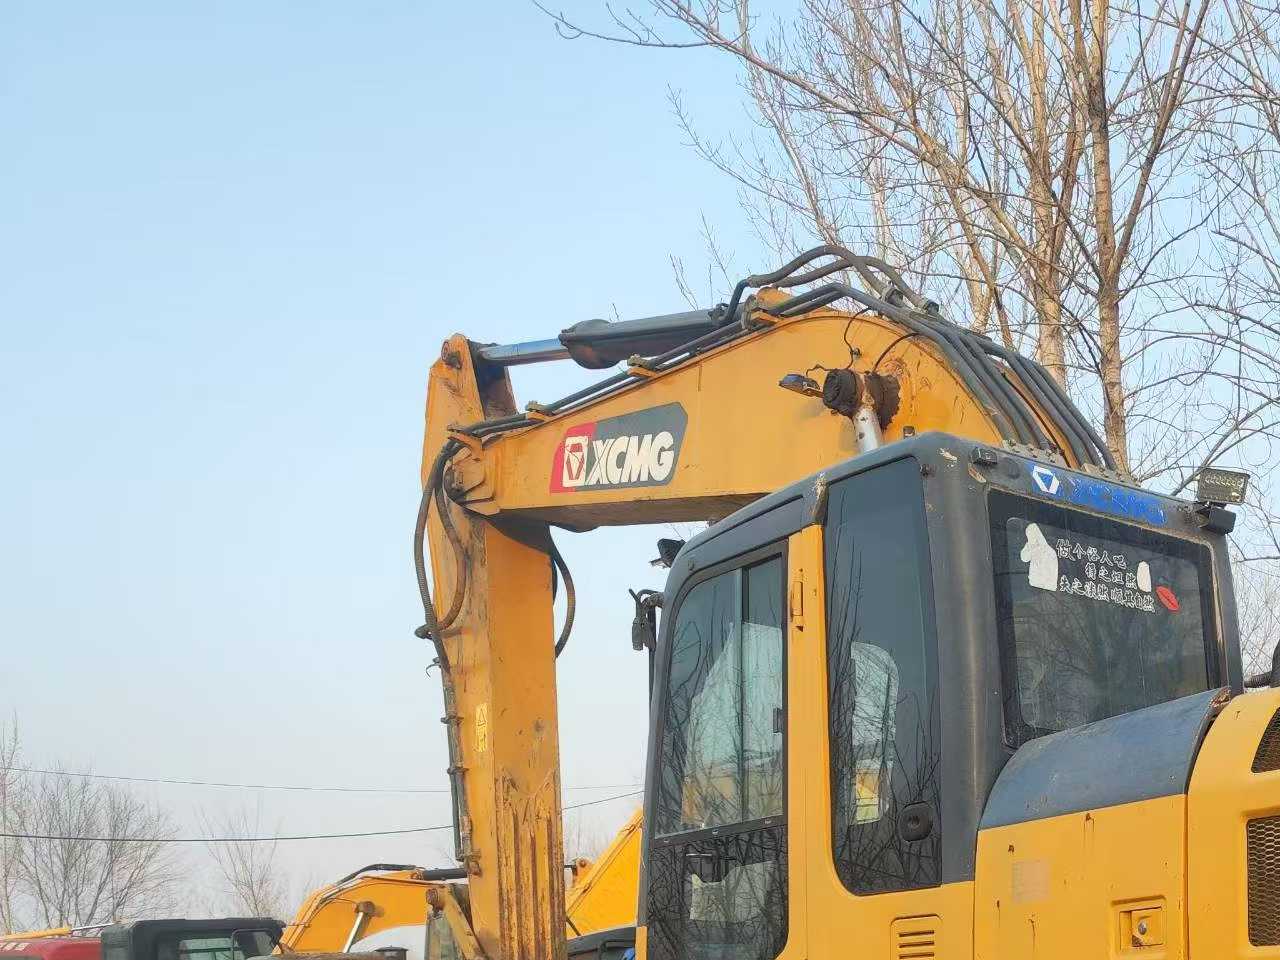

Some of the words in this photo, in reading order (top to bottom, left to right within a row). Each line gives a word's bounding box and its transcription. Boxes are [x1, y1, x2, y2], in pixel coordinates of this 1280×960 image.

[585, 431, 675, 485] XCMG
[1085, 562, 1138, 590] 得之坦然
